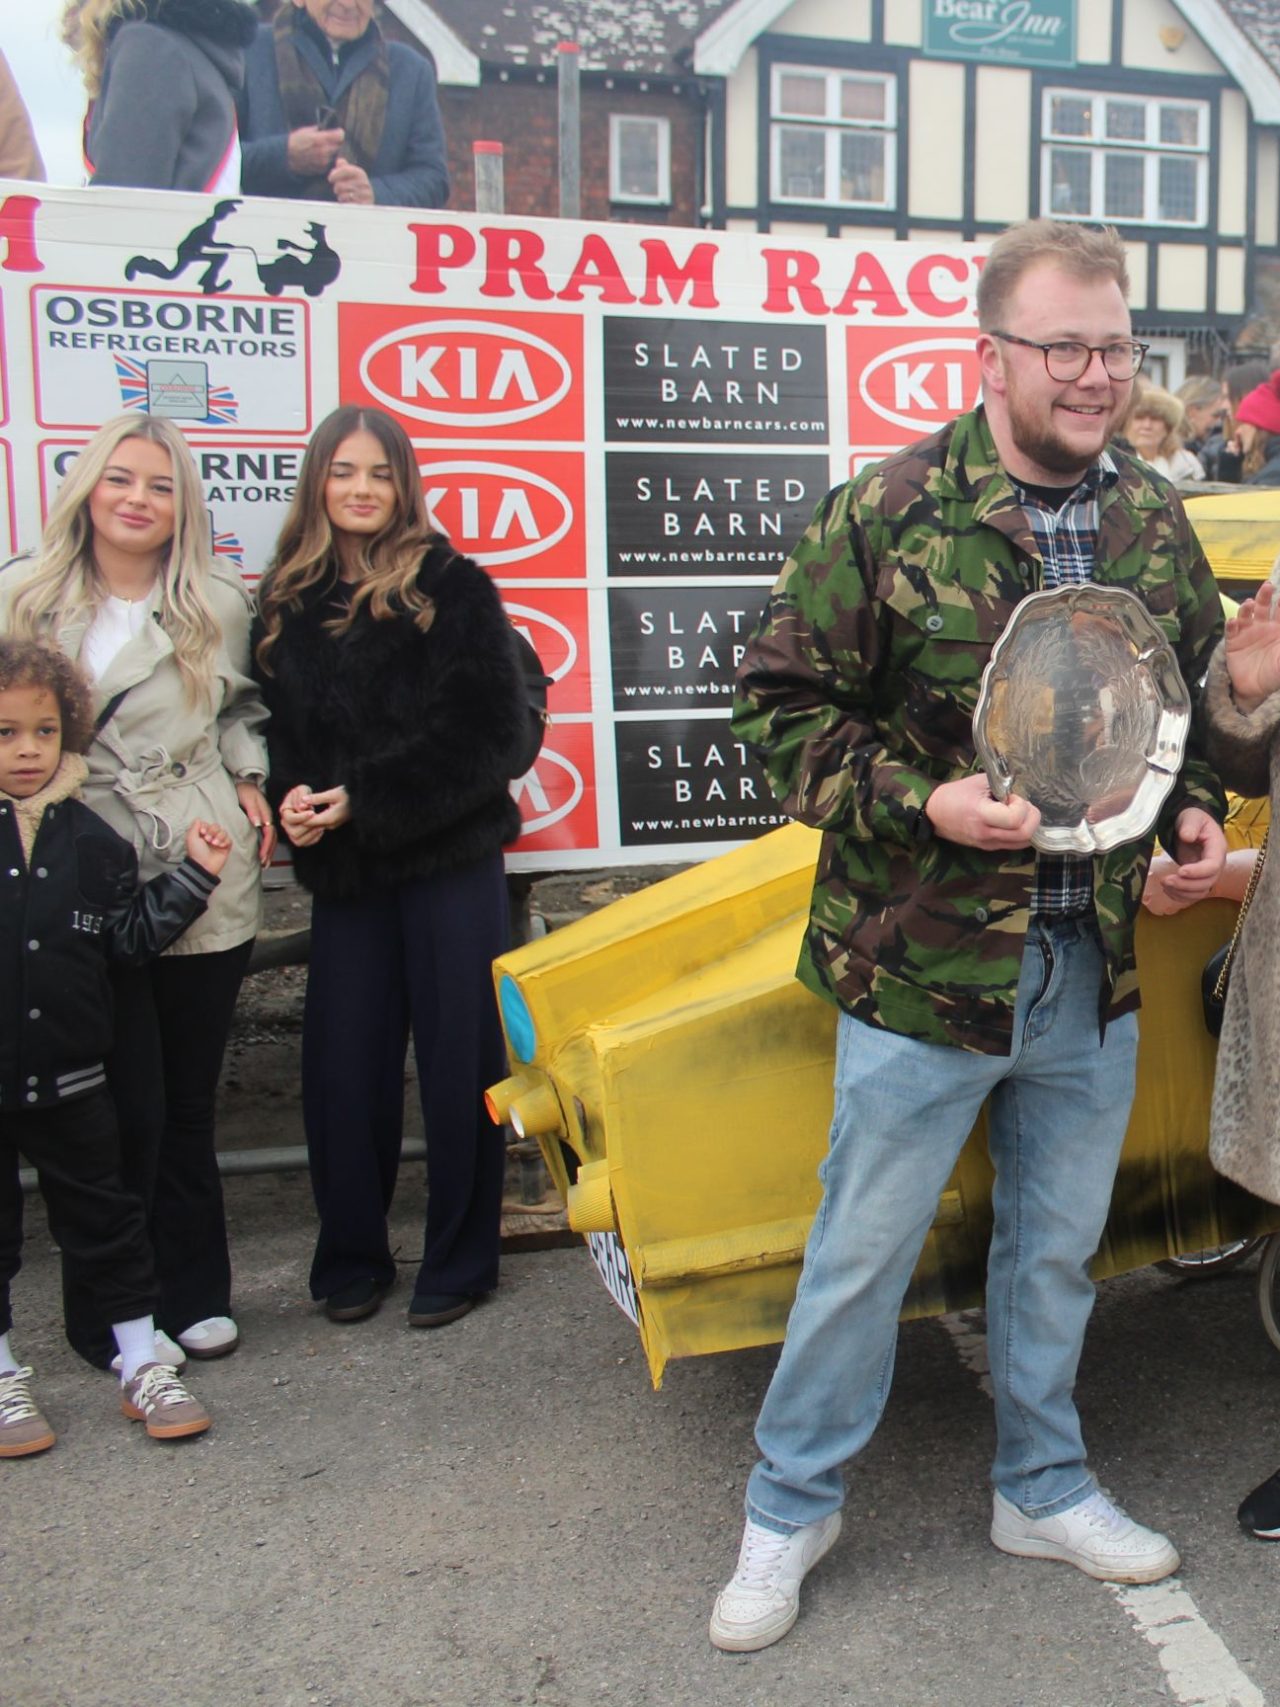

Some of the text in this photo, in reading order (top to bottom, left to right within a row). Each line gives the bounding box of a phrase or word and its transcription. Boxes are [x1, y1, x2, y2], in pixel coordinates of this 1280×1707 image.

[948, 0, 1063, 46] Inn
[407, 223, 720, 309] PRAM
[46, 296, 296, 336] OSBORNE
[49, 331, 297, 358] REFRIGERATORS
[635, 343, 802, 371] SLATED
[398, 344, 539, 401] KIA
[892, 362, 982, 410] KI
[661, 379, 779, 405] BARN
[616, 416, 826, 432] www.newbarncars.com
[637, 477, 805, 502] SLATED
[664, 512, 782, 537] BARN
[640, 610, 764, 636] SLAT
[675, 777, 777, 803] BAR
